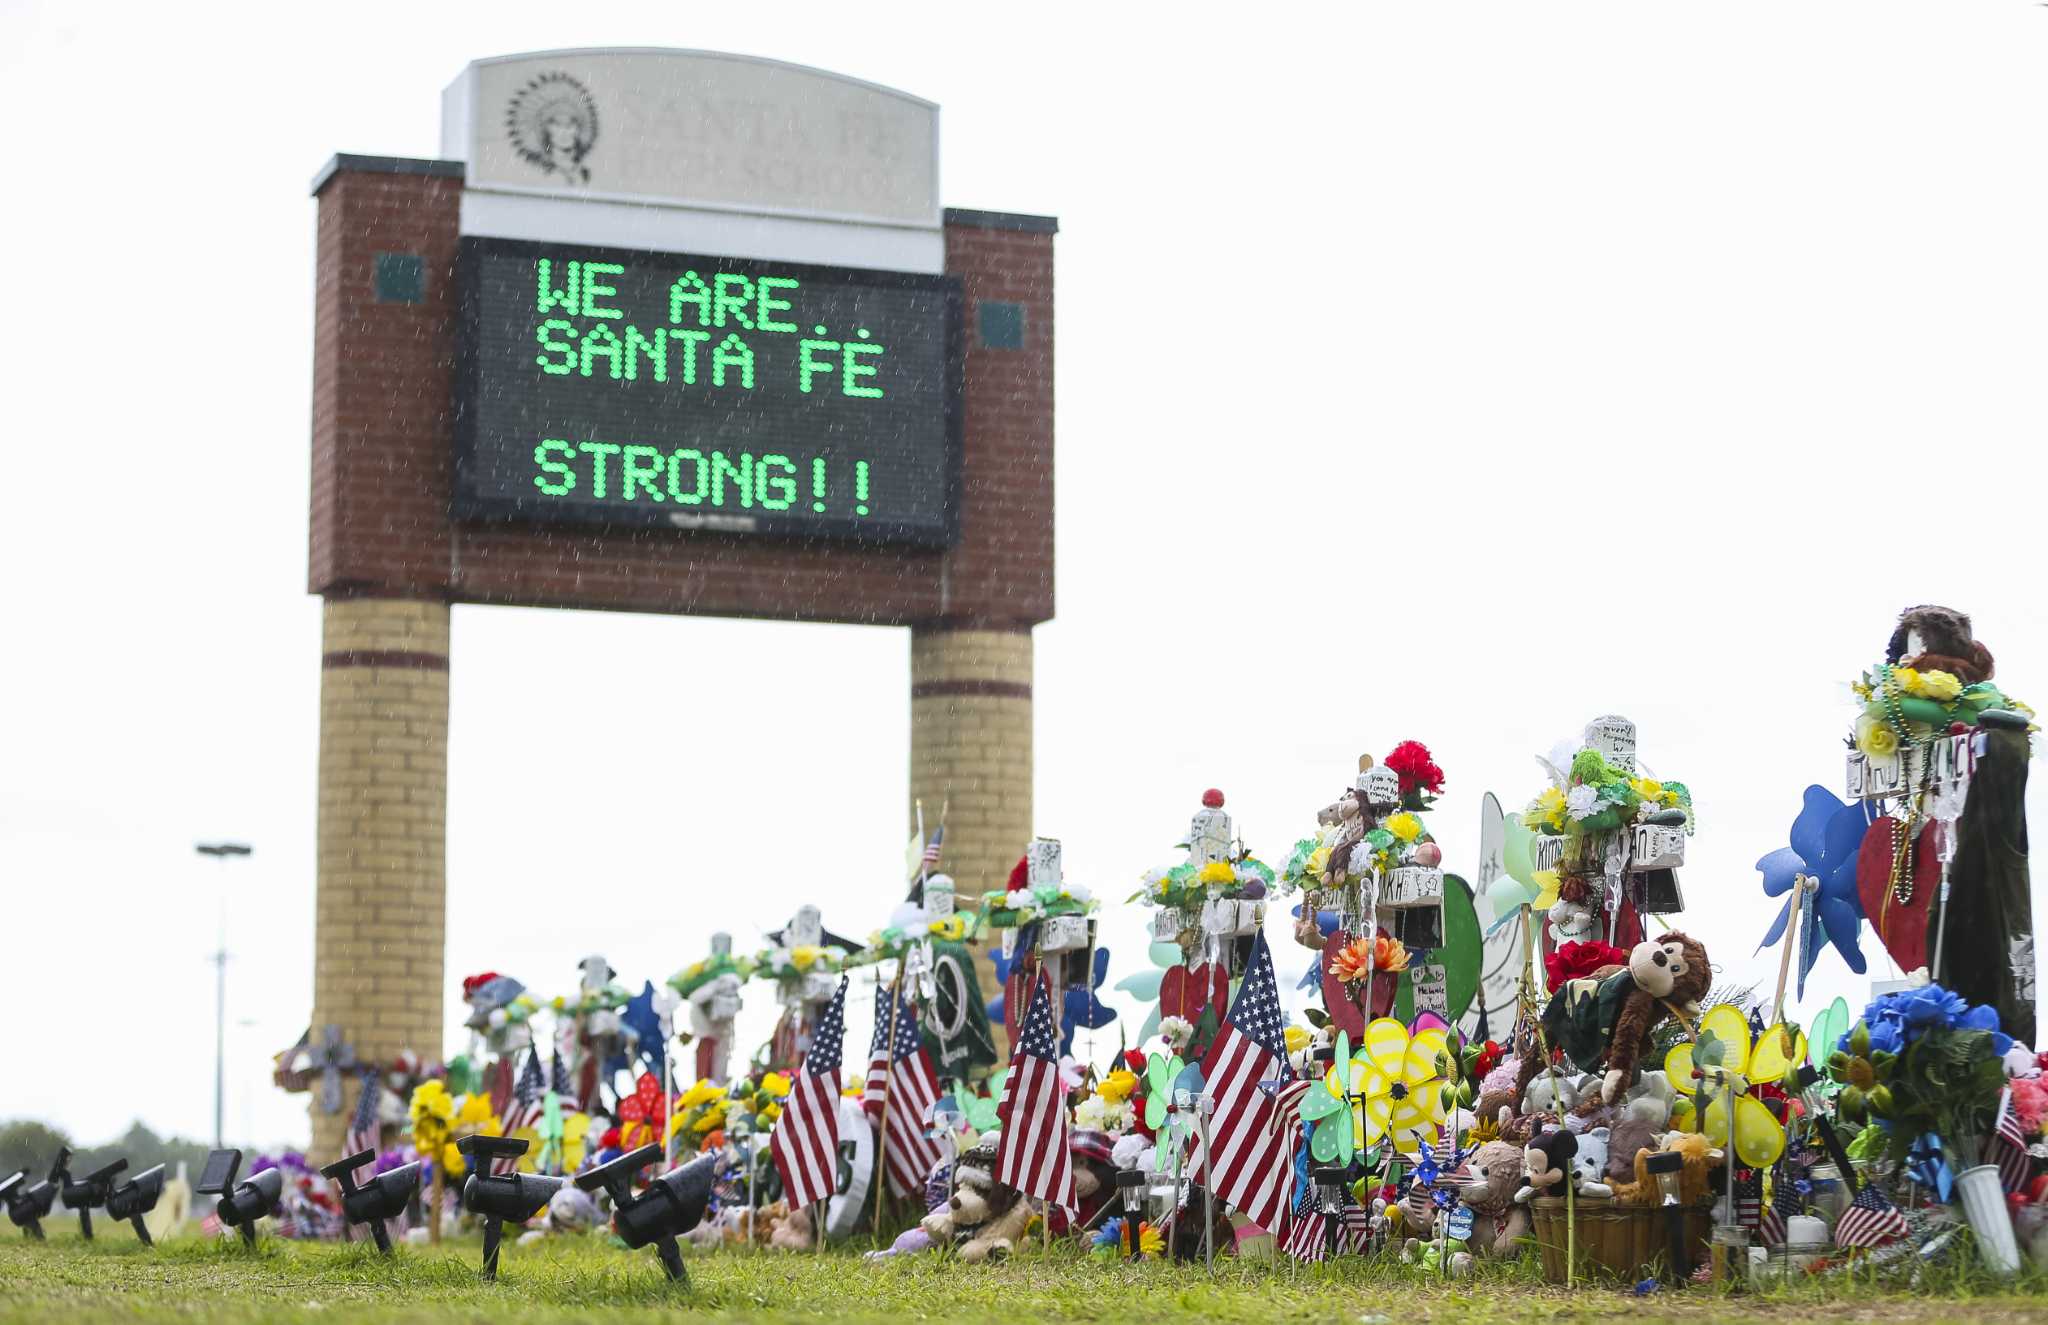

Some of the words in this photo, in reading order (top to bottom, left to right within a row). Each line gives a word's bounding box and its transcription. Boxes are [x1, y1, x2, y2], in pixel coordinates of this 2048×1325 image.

[537, 259, 625, 319] WE
[536, 319, 755, 389] SANTA
[800, 338, 884, 398] FE
